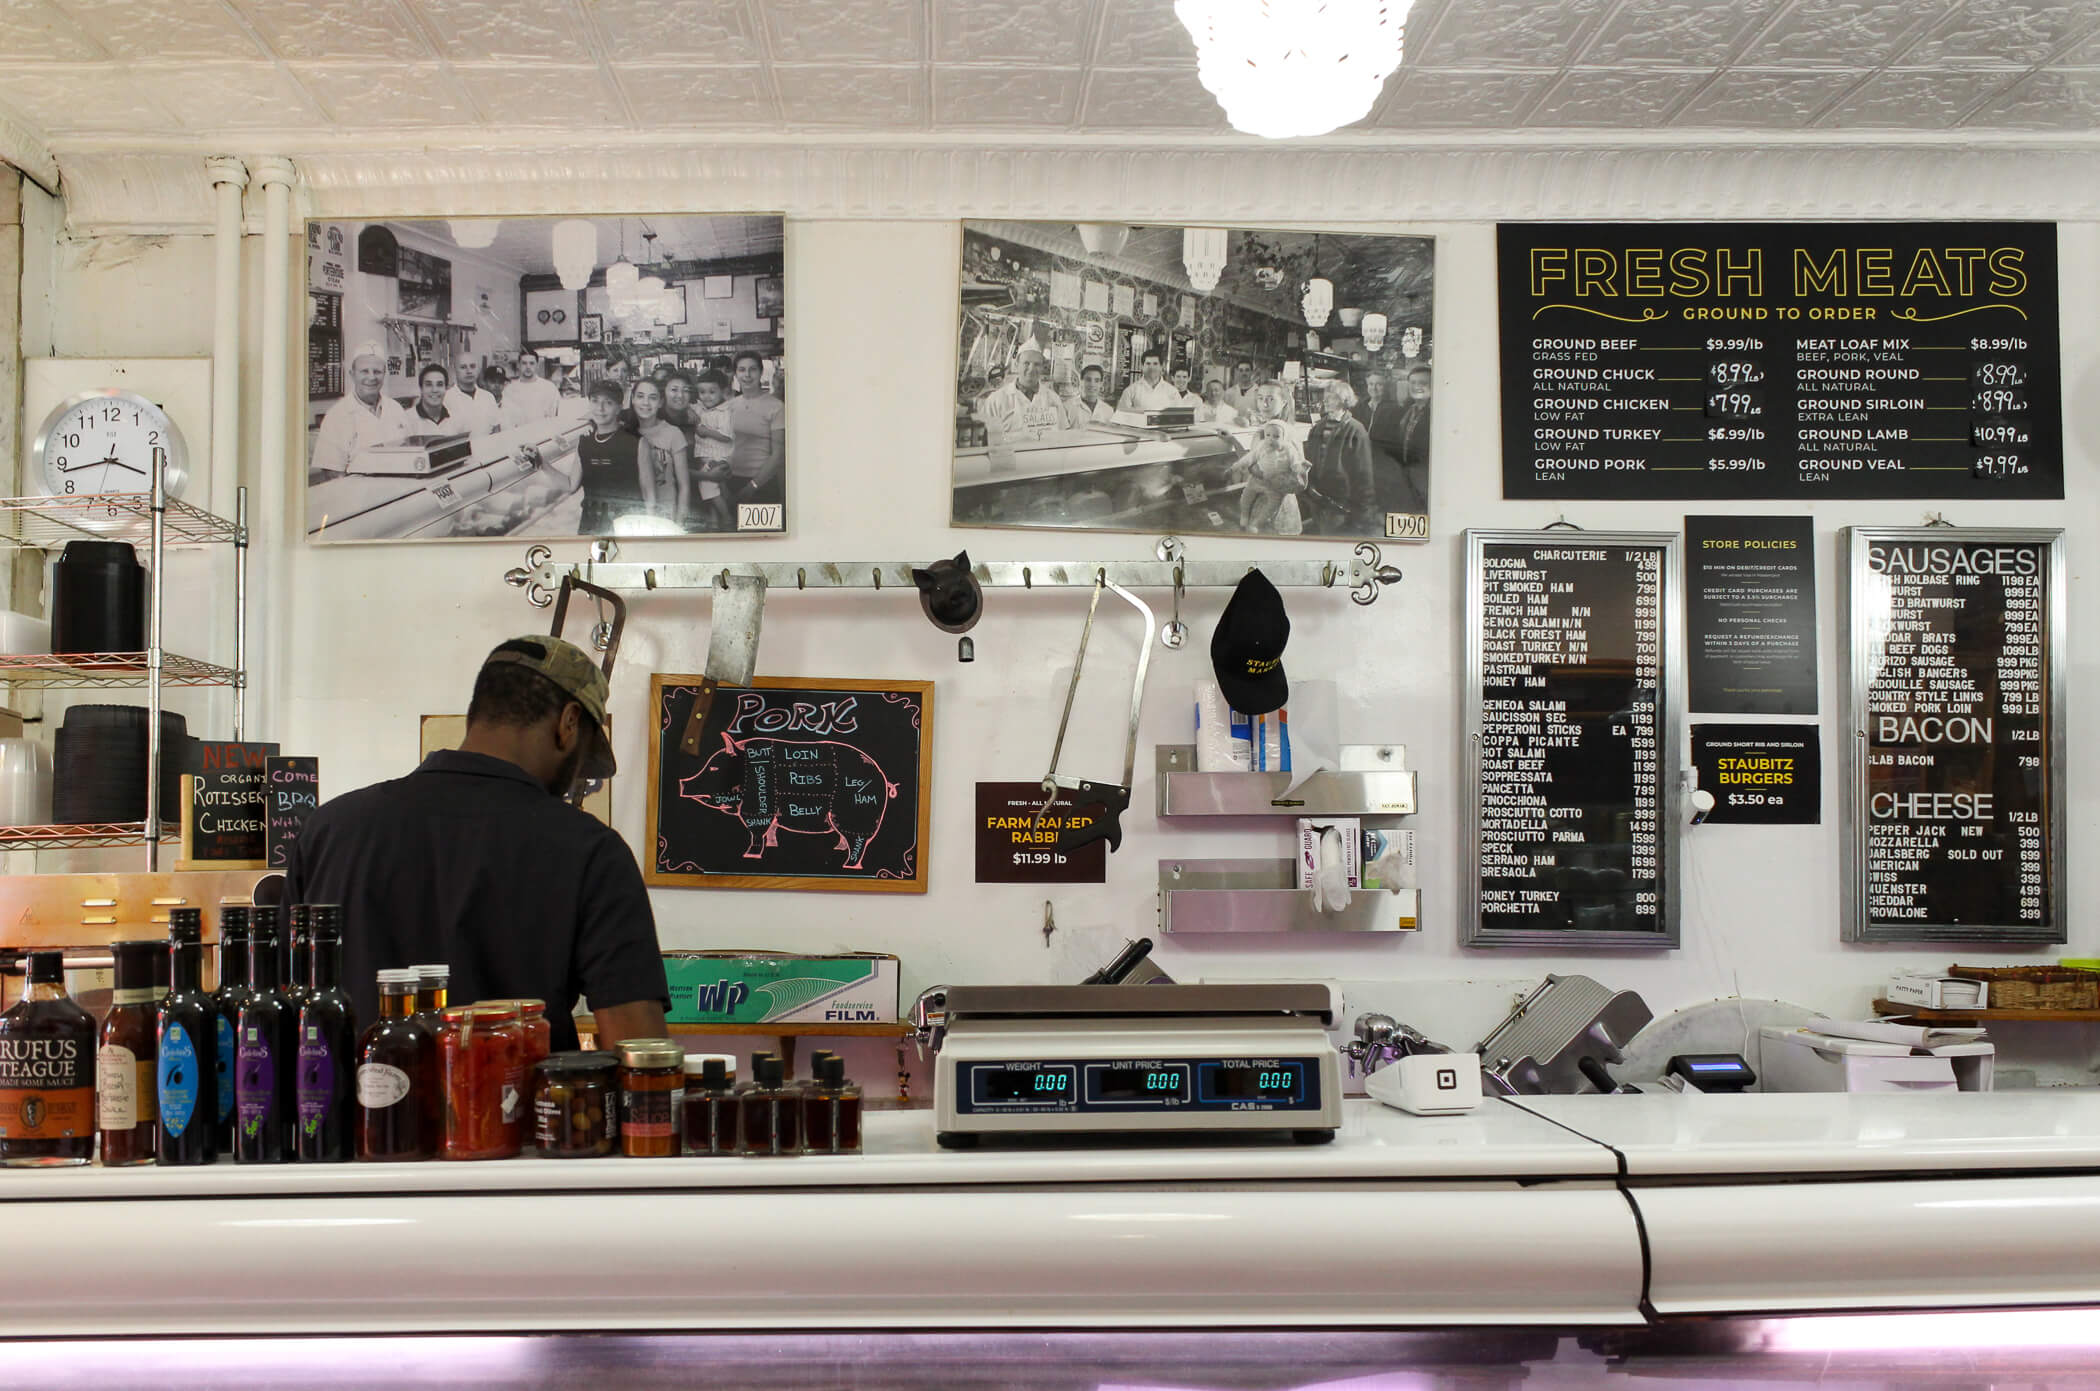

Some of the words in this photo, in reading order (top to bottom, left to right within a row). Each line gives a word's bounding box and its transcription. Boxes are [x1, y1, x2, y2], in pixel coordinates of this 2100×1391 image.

[1531, 248, 1762, 297] FRESH
[1794, 248, 2027, 297] MEATS
[1683, 307, 1768, 321] GROUND
[1777, 307, 1801, 321] TO
[1810, 307, 1876, 321] ORDER
[1533, 339, 1596, 350] GROUND
[1601, 339, 1638, 350] BEEF
[1707, 338, 1763, 351] $9.99/lb
[1797, 340, 1836, 350] MEAT
[1840, 340, 1878, 350] LOAF
[1883, 340, 1910, 350] MIX
[1970, 338, 2027, 351] $8.99/lb
[1533, 352, 1570, 361] GRASS
[1575, 352, 1597, 361] FED
[1797, 352, 1829, 362] BEEF,
[1833, 352, 1870, 362] PORK,
[1874, 352, 1904, 361] VEAL
[1533, 369, 1597, 380] GROUND
[1603, 369, 1654, 380] CHUCK
[1797, 369, 1860, 380] GROUND
[1866, 369, 1919, 380] ROUND
[1533, 383, 1554, 391] ALL
[1558, 383, 1611, 391] NATURAL
[1797, 383, 1818, 391] ALL
[1822, 383, 1876, 391] NATURAL
[1534, 399, 1598, 410] GROUND
[1603, 399, 1669, 410] CHICKEN
[1798, 399, 1861, 410] GROUND
[1866, 399, 1924, 410] SIRLOIN
[103, 408, 120, 421] 12
[134, 412, 139, 426] 1
[1534, 412, 1561, 421] LOW
[1565, 412, 1584, 421] FAT
[1798, 413, 1834, 421] EXTRA
[1837, 413, 1868, 421] LEAN
[79, 416, 93, 429] 11
[149, 431, 158, 445] 2
[1534, 429, 1599, 440] GROUND
[1603, 429, 1661, 440] TURKEY
[1708, 428, 1765, 442] $6.99/lb
[1798, 429, 1862, 440] GROUND
[1867, 429, 1908, 440] LAMB
[62, 434, 80, 448] 10
[1535, 442, 1561, 451] LOW
[1565, 442, 1584, 451] FAT
[1799, 442, 1819, 451] ALL
[1823, 442, 1878, 451] NATURAL
[57, 456, 67, 470] 9
[1535, 459, 1599, 471] GROUND
[1605, 459, 1645, 471] PORK
[1708, 458, 1765, 472] $5.99/lb
[1799, 459, 1863, 470] GROUND
[1867, 459, 1905, 470] VEAL
[1535, 472, 1565, 481] LEAN
[1799, 473, 1829, 482] LEAN
[65, 480, 74, 494] 8
[745, 505, 776, 526] 2007
[1387, 516, 1426, 536] 1990
[1534, 551, 1607, 560] CHARCUTERIE
[1869, 548, 2036, 574] SAUSAGES
[1904, 575, 1949, 584] KOLBASE
[1956, 576, 1980, 585] RING
[1908, 599, 1966, 608] BRATWURST
[1890, 645, 1916, 654] BEEF
[1922, 645, 1948, 654] DOGS
[728, 693, 857, 734] PORK
[1483, 725, 1541, 734] PEPPERONI
[1547, 725, 1582, 735] STICKS
[1636, 727, 1653, 736] 799
[1879, 717, 1992, 743] BACON
[1484, 736, 1519, 746] COPPA
[1529, 737, 1579, 746] PICANTE
[1631, 739, 1655, 747] 1599
[203, 744, 266, 769] NEW
[747, 748, 771, 759] BUTT
[785, 749, 819, 760] LOIN
[1482, 760, 1513, 769] ROAST
[1519, 761, 1545, 770] BEEF
[1634, 762, 1655, 771] 1199
[1718, 759, 1794, 769] STAUBITZ
[1898, 756, 1934, 766] BACON
[220, 774, 266, 783] ORGANI
[272, 770, 318, 782] COME
[790, 774, 822, 785] RIBS
[1482, 772, 1552, 782] SOPPRESSATA
[1634, 774, 1655, 783] 1199
[1720, 773, 1793, 784] BURGERS
[755, 765, 767, 814] SHOULDER
[715, 795, 741, 804] JOWL
[854, 794, 877, 804] HAM
[1729, 793, 1764, 806] $3.50
[789, 805, 822, 816] BELLY
[1872, 793, 1994, 819] CHEESE
[746, 818, 771, 827] SHANK
[987, 817, 1030, 828] FARM
[1481, 831, 1544, 841] PROSCIUTTO
[1553, 832, 1584, 842] PARMA
[1916, 826, 1946, 835] JACK
[1961, 827, 1983, 836] NEW
[2018, 827, 2039, 836] 500
[1304, 829, 1312, 849] GUARD
[1632, 834, 1655, 843] 1599
[850, 836, 864, 861] SHANK
[1013, 853, 1050, 865] $11.99
[1055, 854, 1066, 863] lb
[1948, 850, 1976, 859] SOLD
[1982, 850, 2003, 860] OUT
[1305, 872, 1313, 888] SAFE
[1481, 891, 1515, 901] HONEY
[1520, 892, 1559, 901] TURKEY
[1636, 893, 1655, 902] 800
[1481, 903, 1540, 913] PORCHETTA
[1636, 905, 1655, 914] 899
[831, 1001, 872, 1009] Foodservice
[826, 1011, 875, 1020] FILM
[0, 1040, 77, 1060] RUFUS
[0, 1061, 75, 1077] TEAGUE
[1006, 1063, 1042, 1071] WEIGHT
[1136, 1061, 1162, 1069] PRICE
[1222, 1060, 1250, 1068] TOTAL
[1253, 1060, 1280, 1068] PRICE
[1034, 1075, 1067, 1090] 0.00
[1147, 1073, 1179, 1089] 0.00
[1259, 1073, 1292, 1088] 0.00
